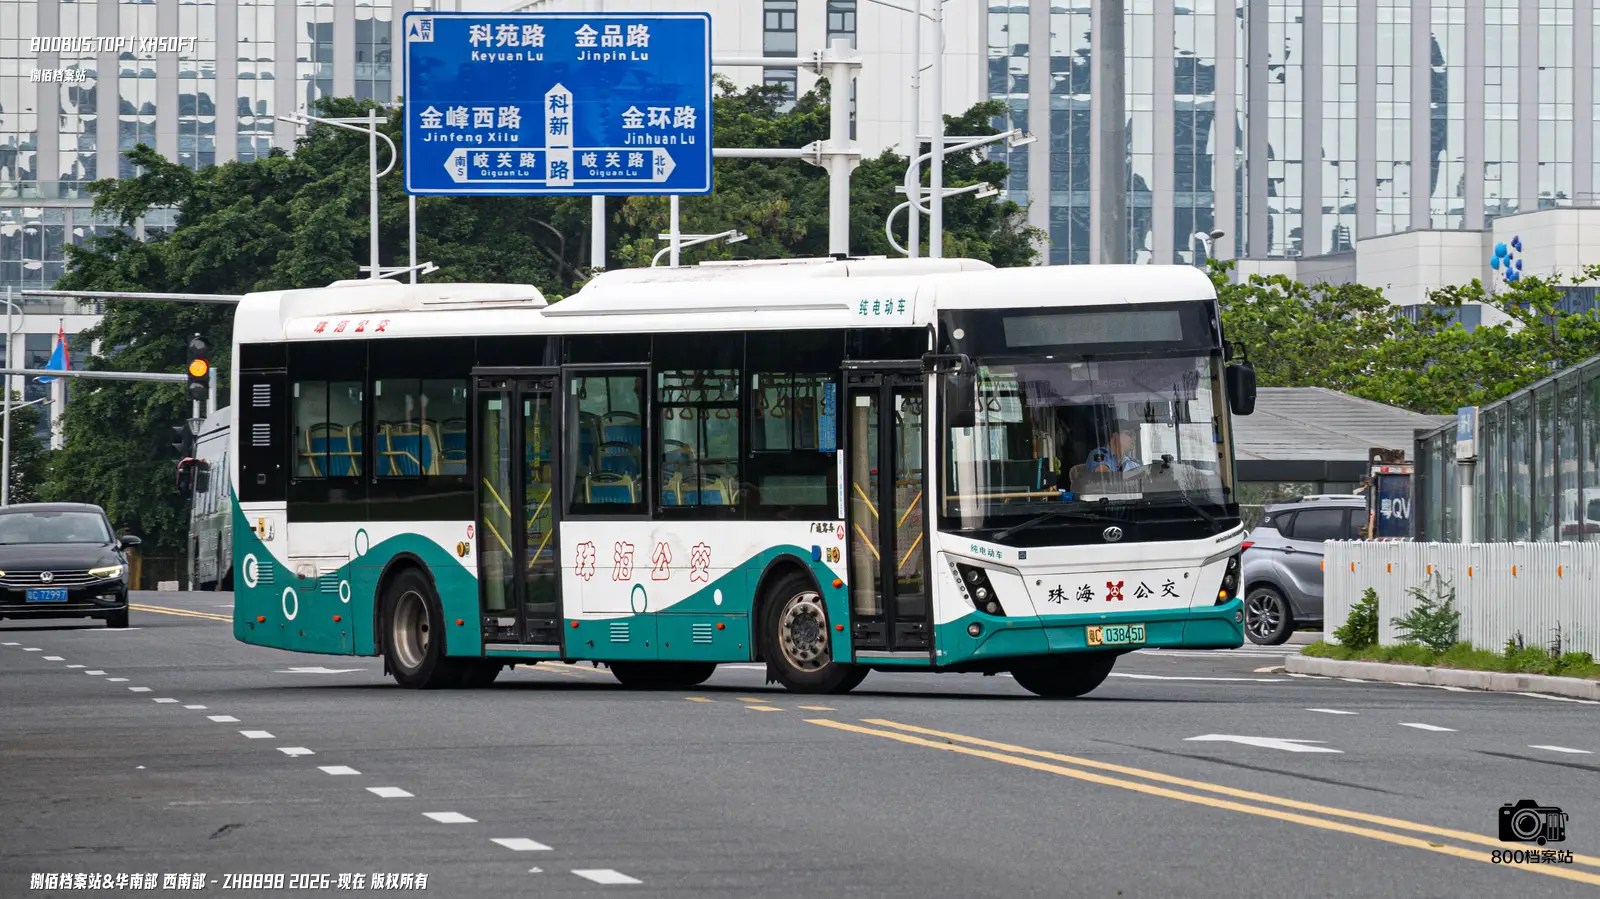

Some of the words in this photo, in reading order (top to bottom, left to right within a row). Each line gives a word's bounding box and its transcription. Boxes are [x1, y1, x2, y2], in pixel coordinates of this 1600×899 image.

[419, 19, 432, 31] 西
[421, 32, 430, 40] W
[469, 24, 546, 48] 科苑路
[574, 24, 651, 48] 金品路
[471, 51, 523, 63] Keyuan
[527, 51, 544, 61] Lu
[577, 51, 627, 63] Jinpin
[631, 51, 649, 61] Lu
[419, 105, 522, 130] 金峰西路
[621, 105, 698, 130] 金环路
[423, 132, 483, 144] Jinfeng
[488, 132, 519, 142] Xilu
[549, 93, 570, 181] 科新一路
[624, 132, 677, 145] Jinhuan
[680, 132, 696, 145] Lu
[454, 155, 466, 168] 南
[473, 152, 537, 168] 岐关路
[581, 152, 645, 168] 岐关路
[654, 154, 666, 167] 北
[457, 168, 465, 177] S
[626, 169, 638, 177] Lu
[656, 167, 664, 176] N
[858, 297, 907, 316] 纯电动车
[969, 543, 1003, 560] 纯电动车
[574, 541, 712, 583] 珠海公交
[1047, 583, 1095, 605] 珠海
[1132, 578, 1181, 600] 公交
